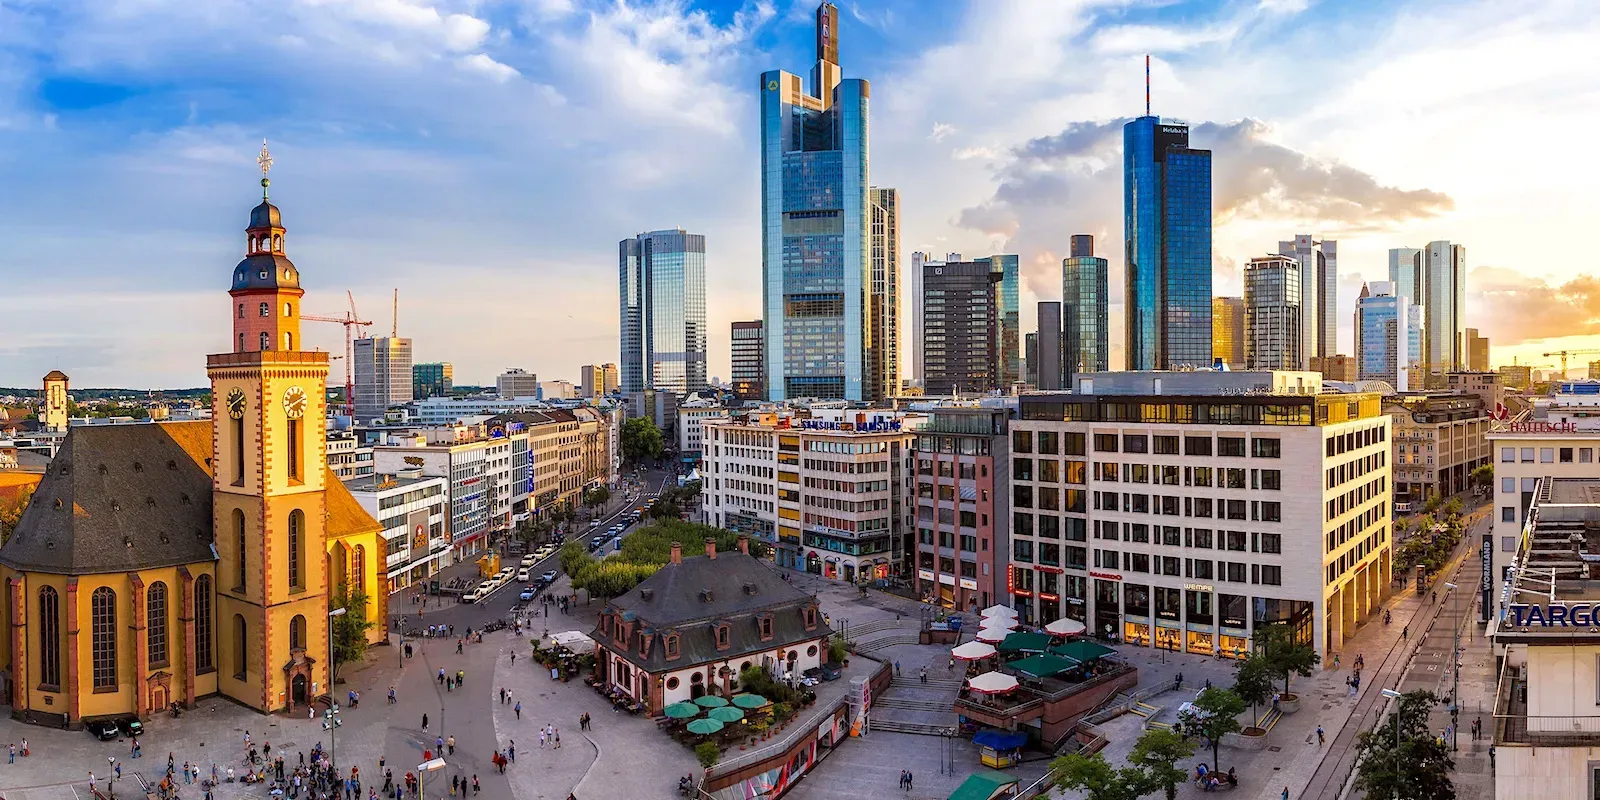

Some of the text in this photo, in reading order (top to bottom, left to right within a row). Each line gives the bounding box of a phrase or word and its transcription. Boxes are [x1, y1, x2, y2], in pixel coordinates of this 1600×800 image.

[802, 420, 841, 431] SAMSUNG
[856, 421, 901, 432] SAMSUNG
[1510, 421, 1577, 434] HALLESCHE
[1483, 541, 1491, 591] WORMLAND
[1184, 583, 1213, 592] WEMPE
